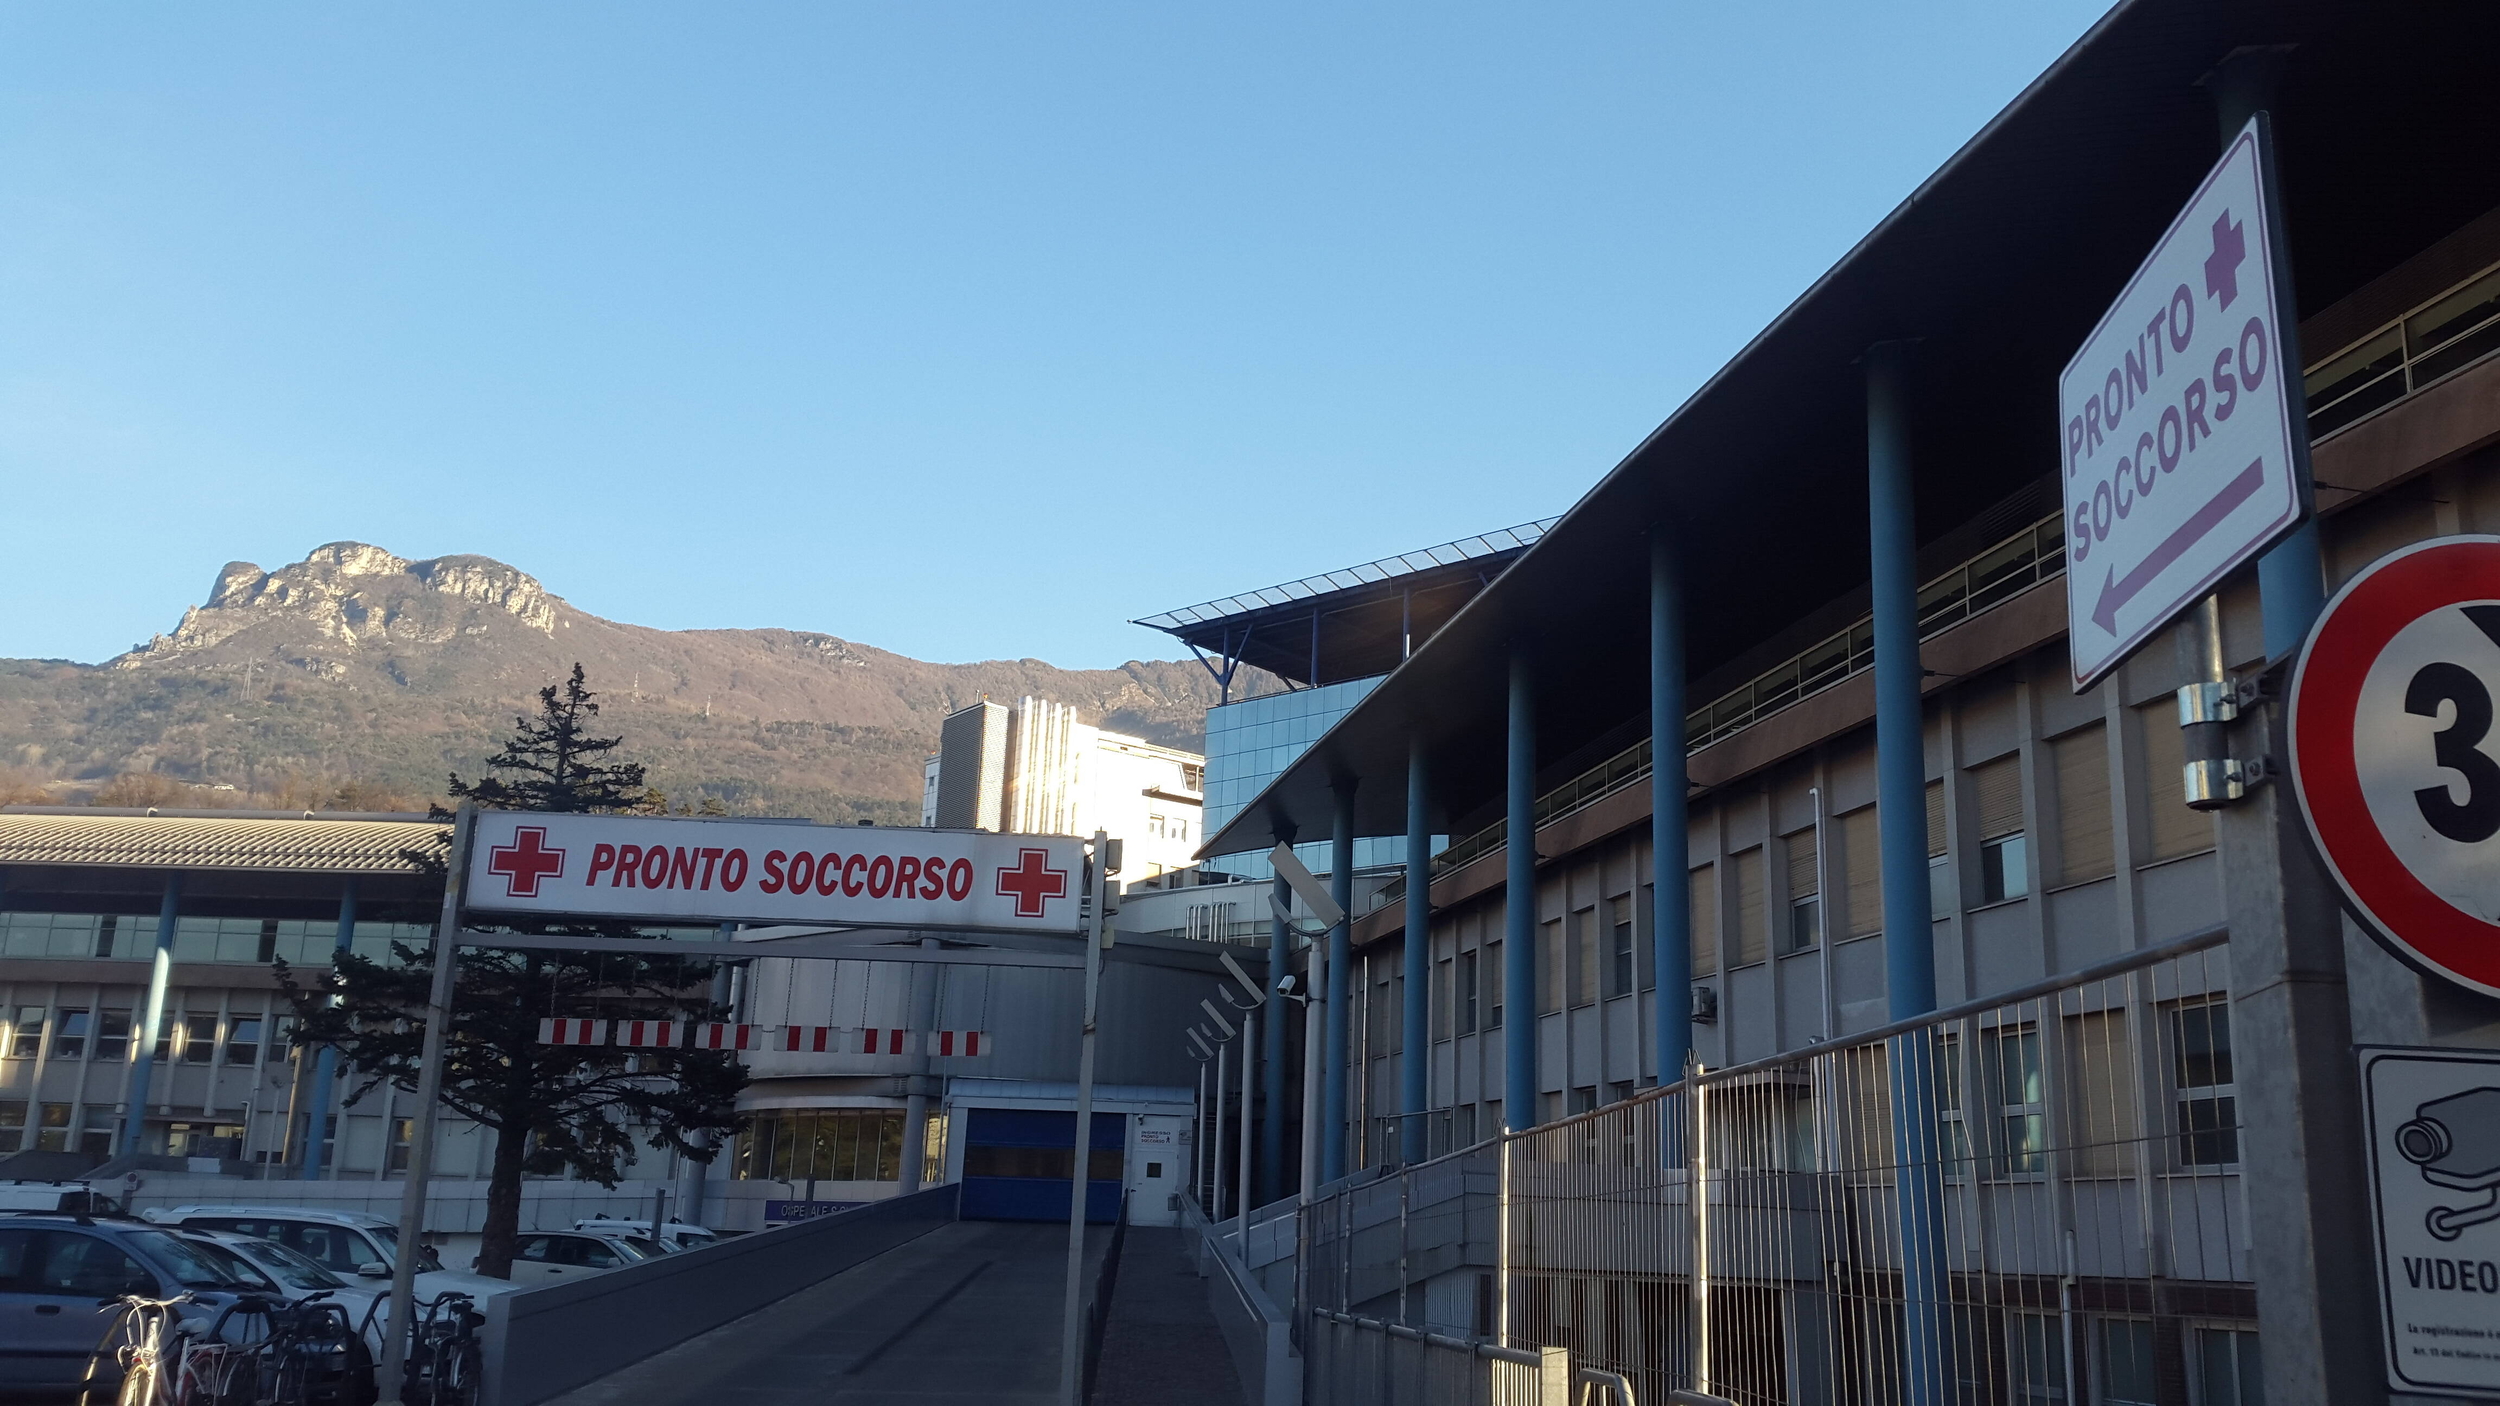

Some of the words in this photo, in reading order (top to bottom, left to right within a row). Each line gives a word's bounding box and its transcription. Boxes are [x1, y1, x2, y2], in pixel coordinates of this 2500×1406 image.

[2068, 283, 2195, 478] PRONTO
[2074, 316, 2268, 562] SOCCORSO
[2404, 661, 2500, 844] 3
[585, 843, 749, 893] PRONTO
[759, 849, 974, 902] SOCCORSO
